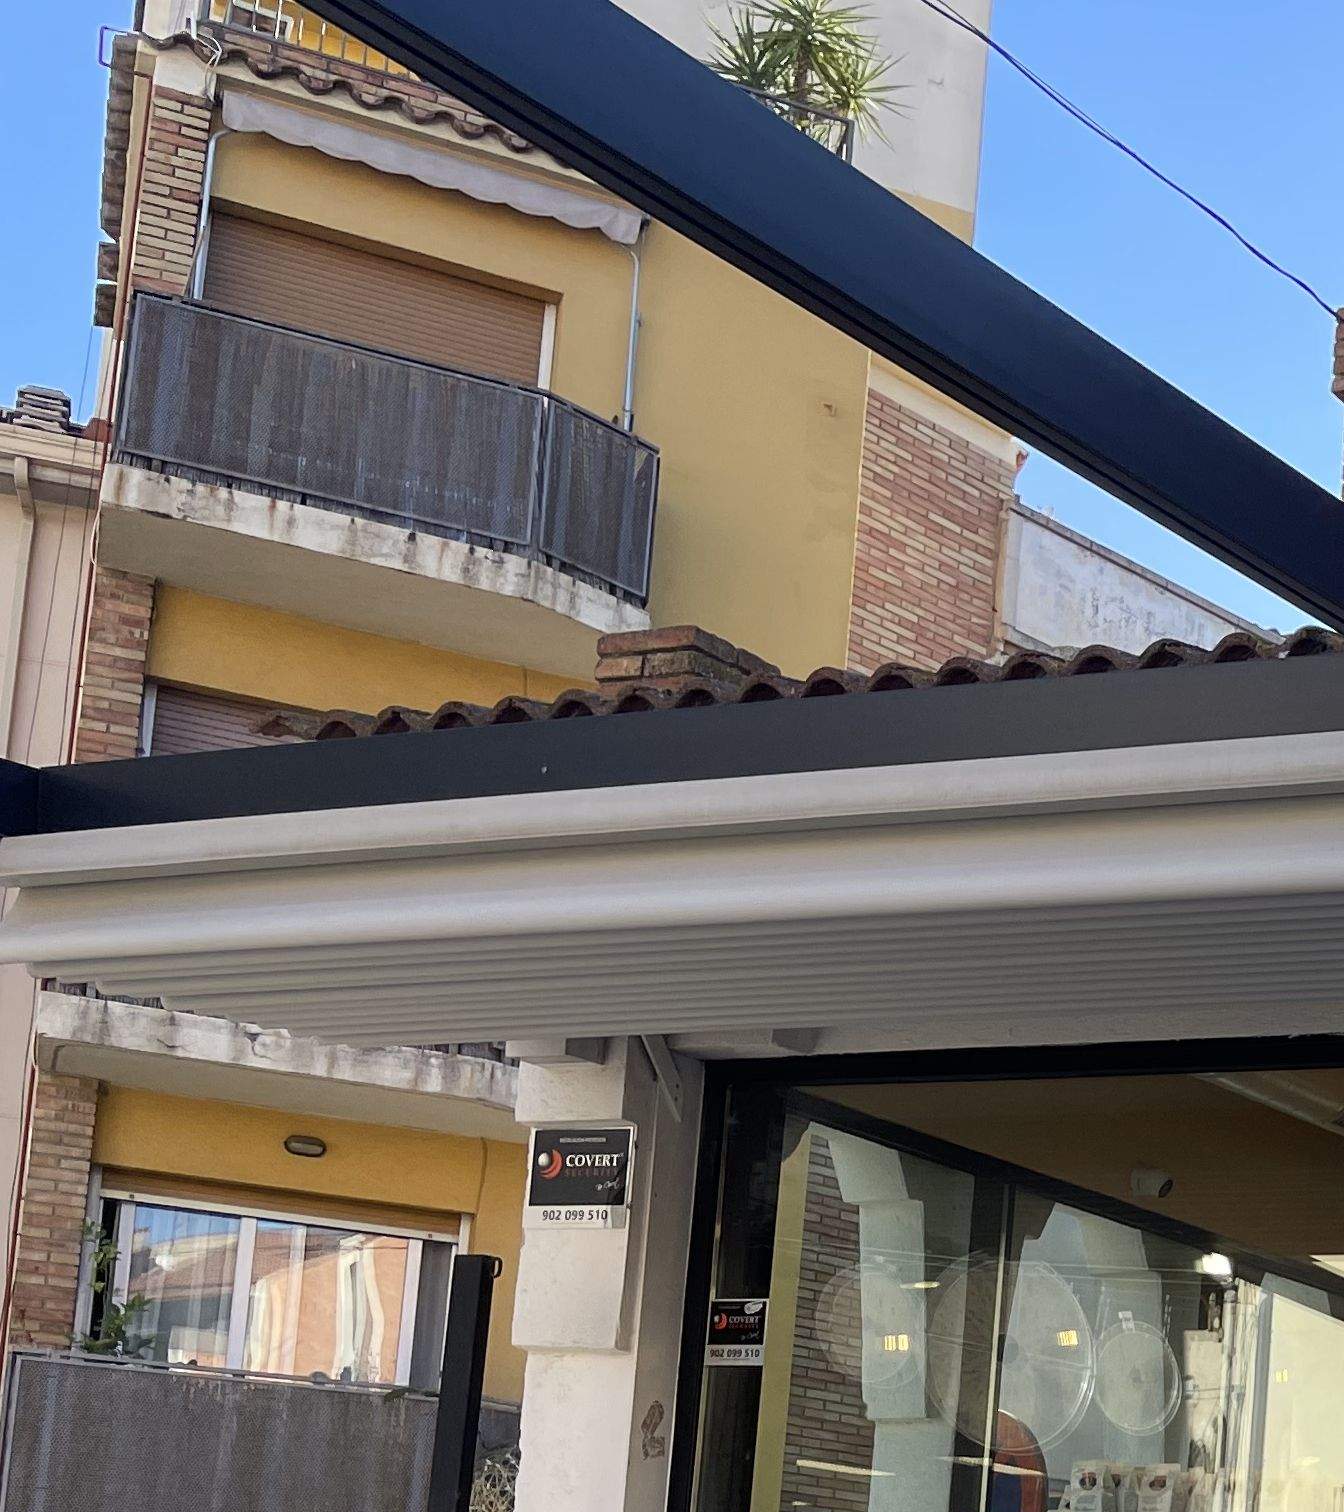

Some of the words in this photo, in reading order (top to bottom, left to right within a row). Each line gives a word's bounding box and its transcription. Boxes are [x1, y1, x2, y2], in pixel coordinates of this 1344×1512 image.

[565, 1153, 619, 1167] COVERT
[542, 1209, 561, 1221] 902
[565, 1209, 585, 1221] 099
[588, 1209, 608, 1221] 510
[729, 1315, 760, 1324] COVERT
[709, 1349, 725, 1358] 902
[727, 1349, 743, 1358] 099
[744, 1349, 760, 1358] 510
